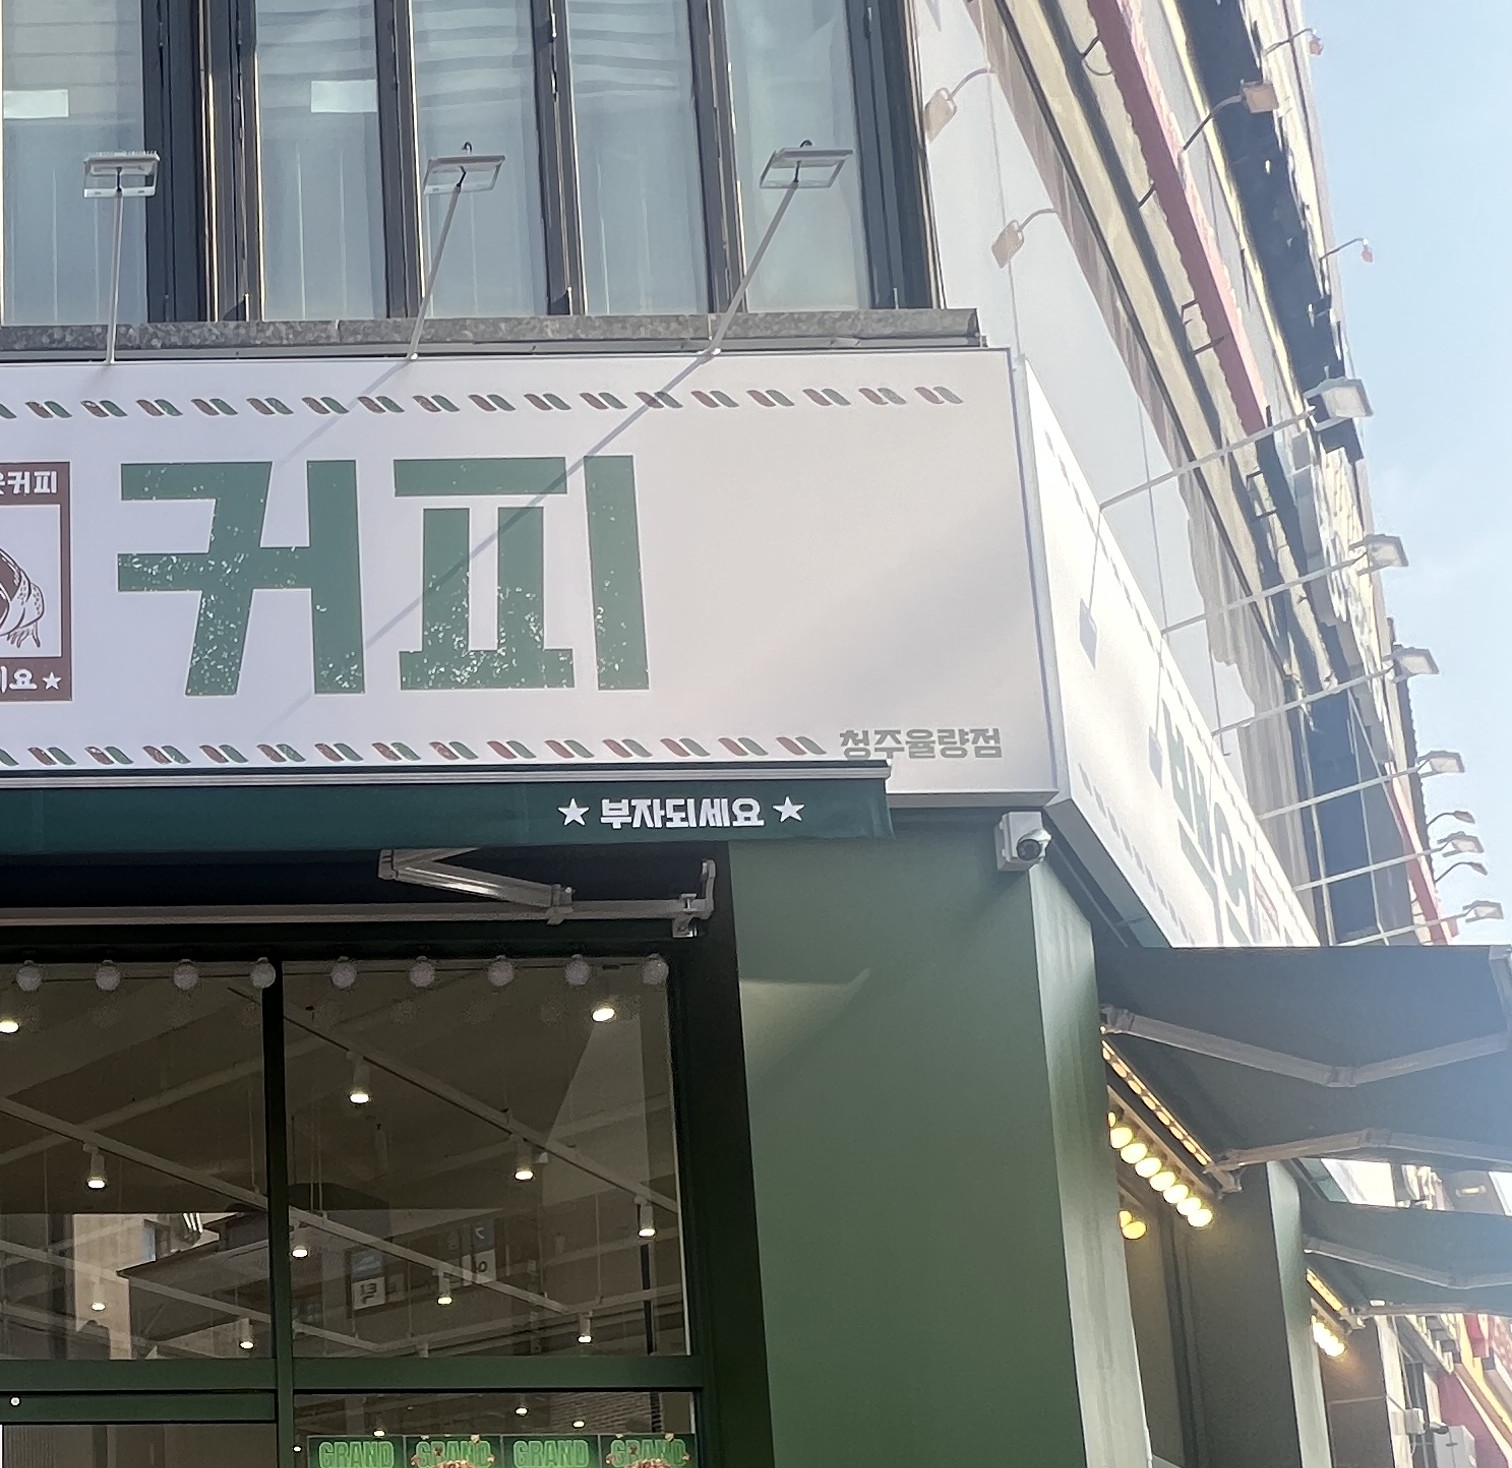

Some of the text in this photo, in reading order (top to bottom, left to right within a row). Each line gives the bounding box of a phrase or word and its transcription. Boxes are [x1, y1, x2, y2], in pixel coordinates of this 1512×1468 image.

[118, 454, 650, 697] 커피
[839, 727, 1003, 760] 청주율량점
[599, 797, 765, 830] 부자되세요
[513, 1440, 589, 1468] GRAND
